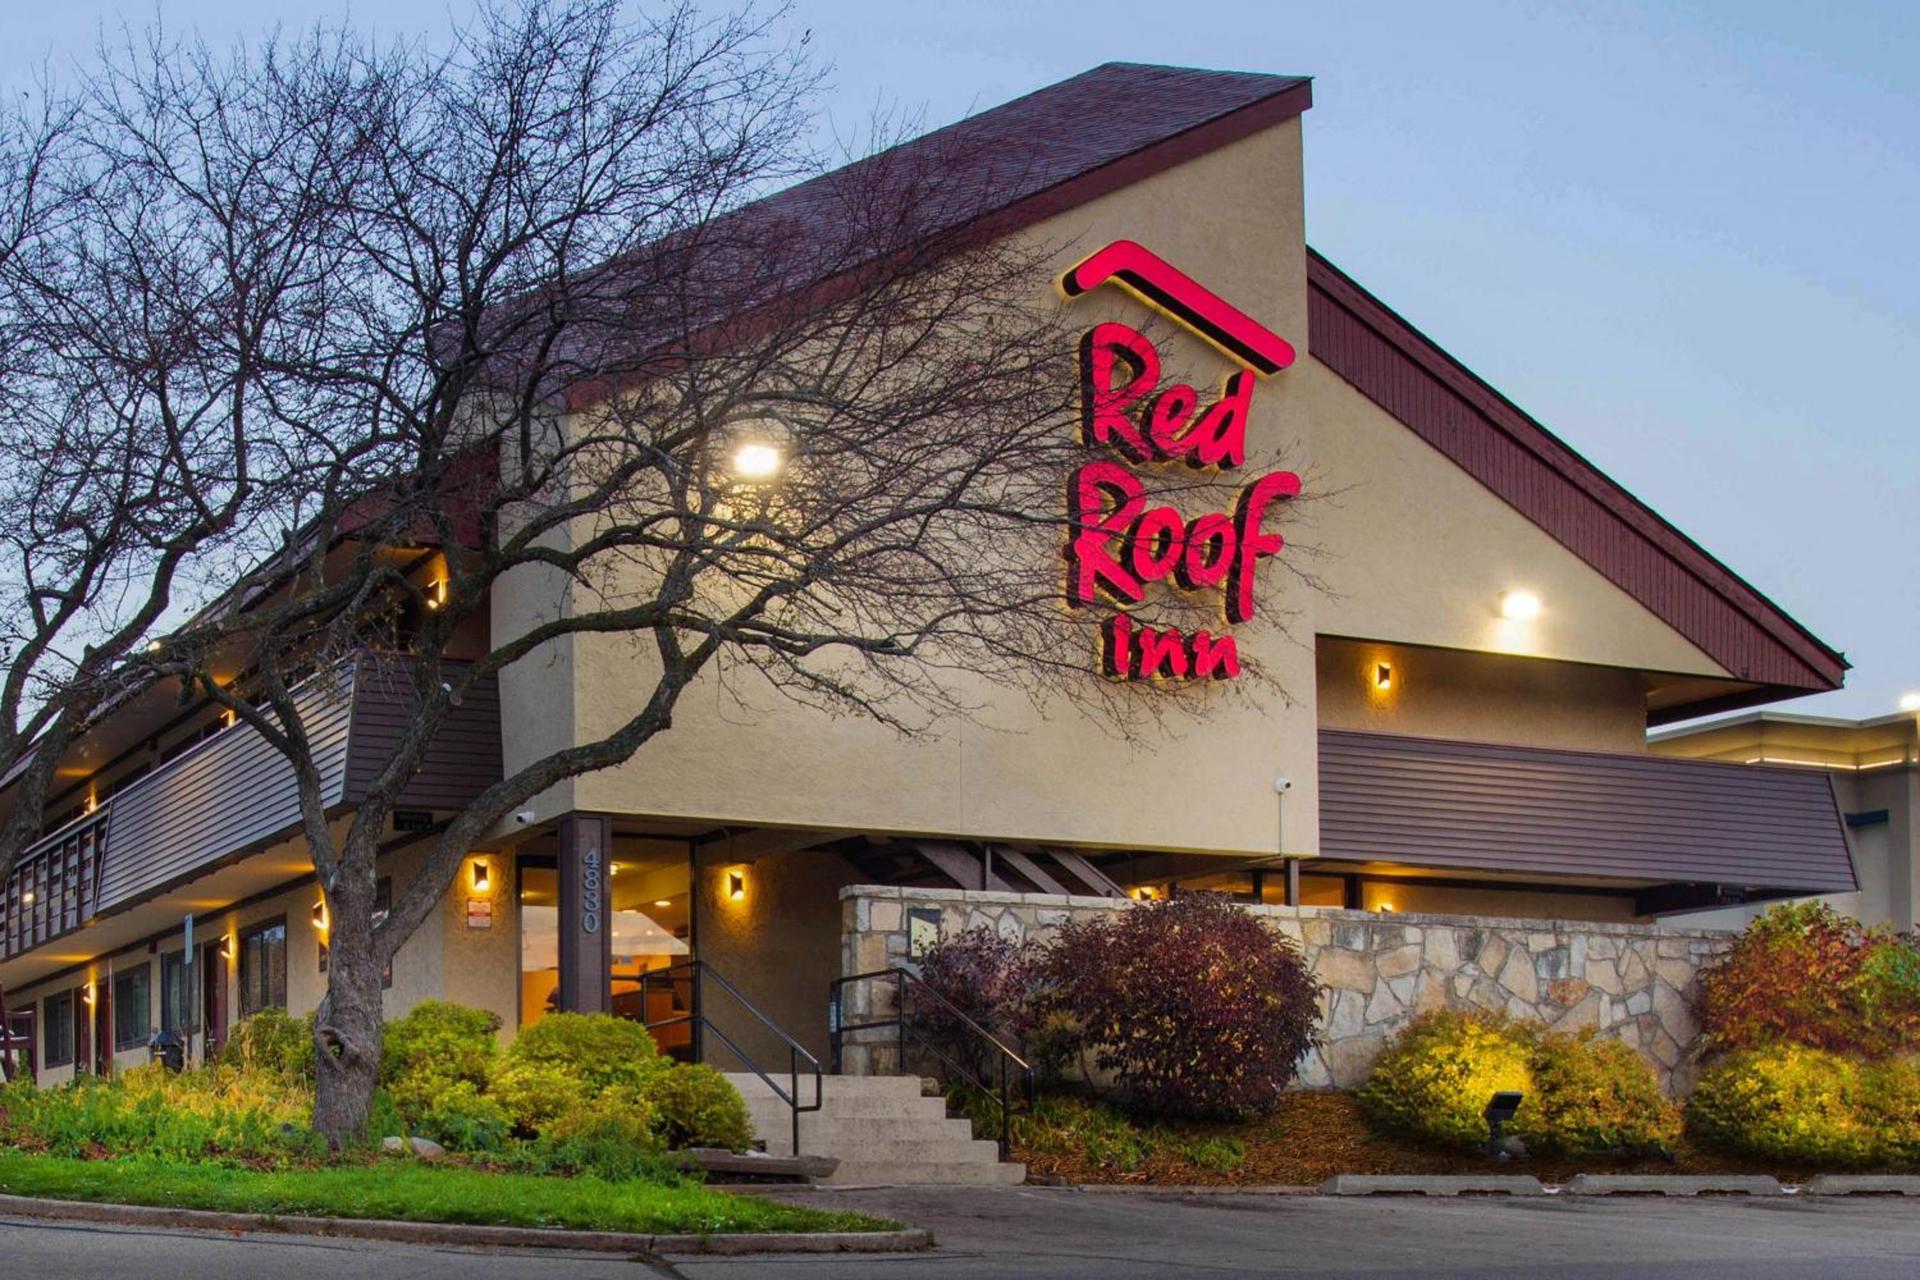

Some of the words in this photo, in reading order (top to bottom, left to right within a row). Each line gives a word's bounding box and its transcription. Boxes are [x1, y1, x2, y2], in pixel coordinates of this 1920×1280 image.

[1081, 321, 1257, 468] Red
[1069, 461, 1302, 623] Roof
[583, 847, 600, 933] 4830
